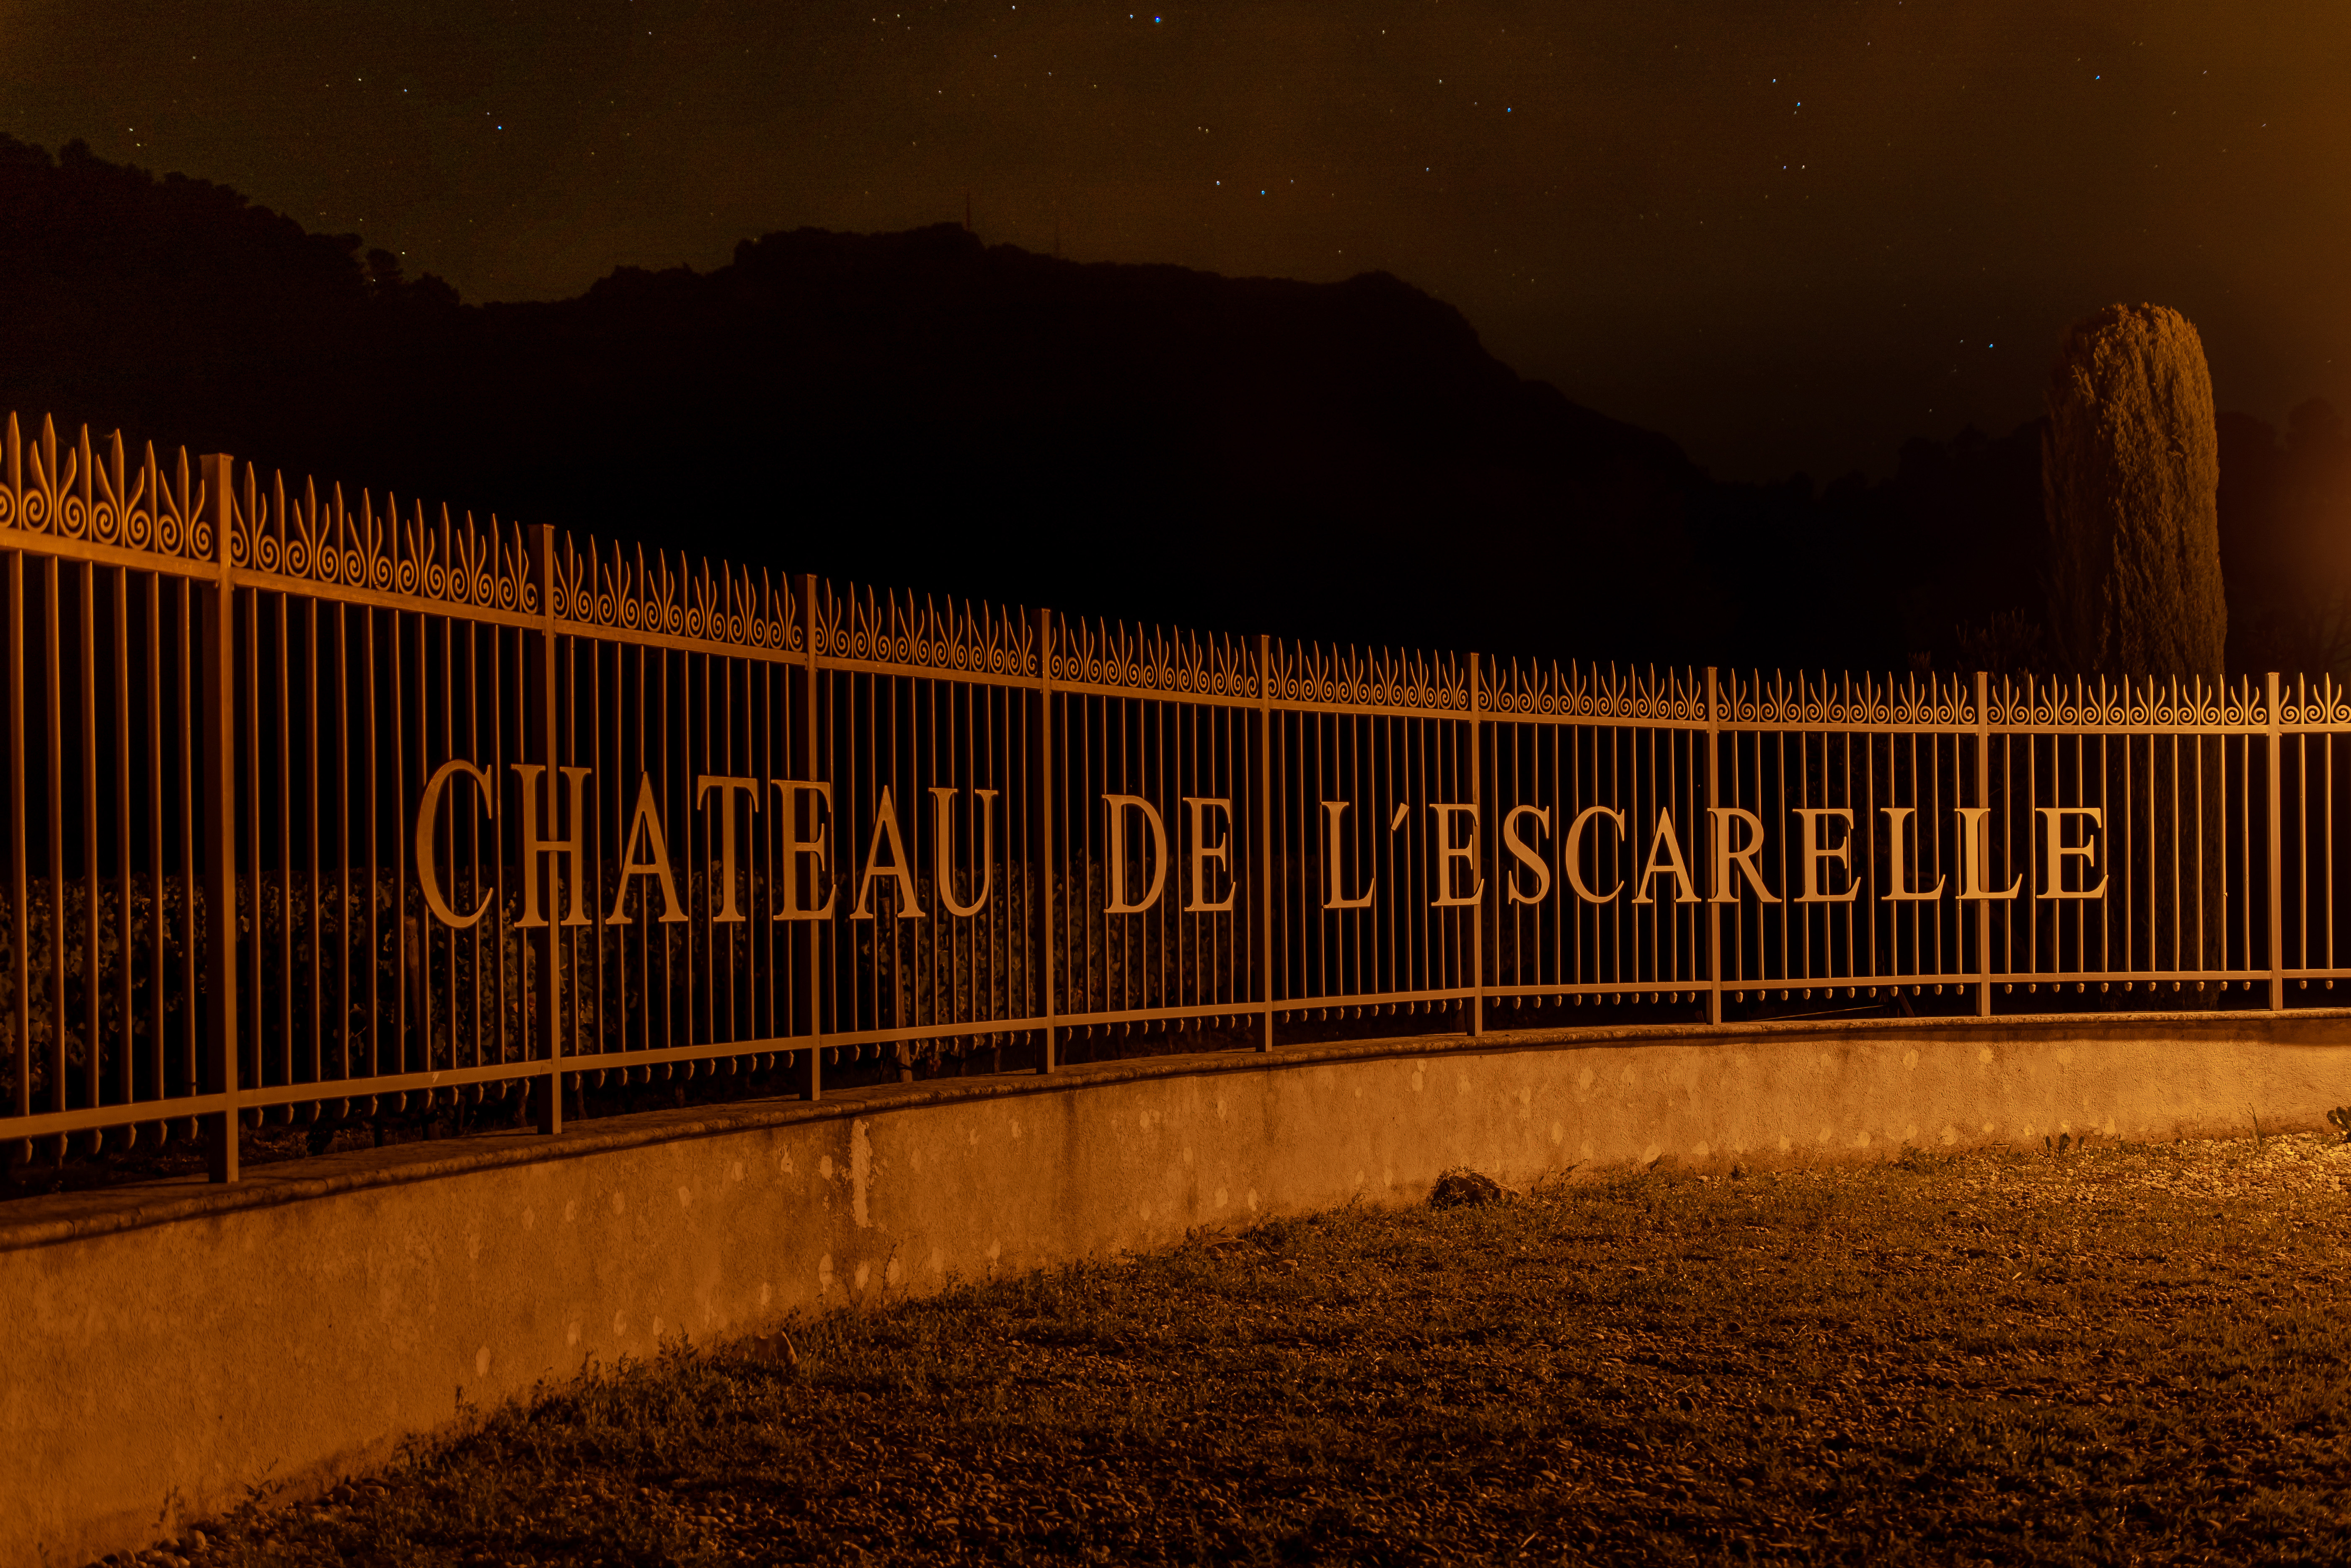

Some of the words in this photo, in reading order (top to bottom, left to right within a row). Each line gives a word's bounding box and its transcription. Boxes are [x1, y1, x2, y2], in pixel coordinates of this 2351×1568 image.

[417, 759, 999, 928] CHATEAU
[1102, 794, 1235, 914] DE
[1321, 801, 2108, 909] L'ESCARELLE
